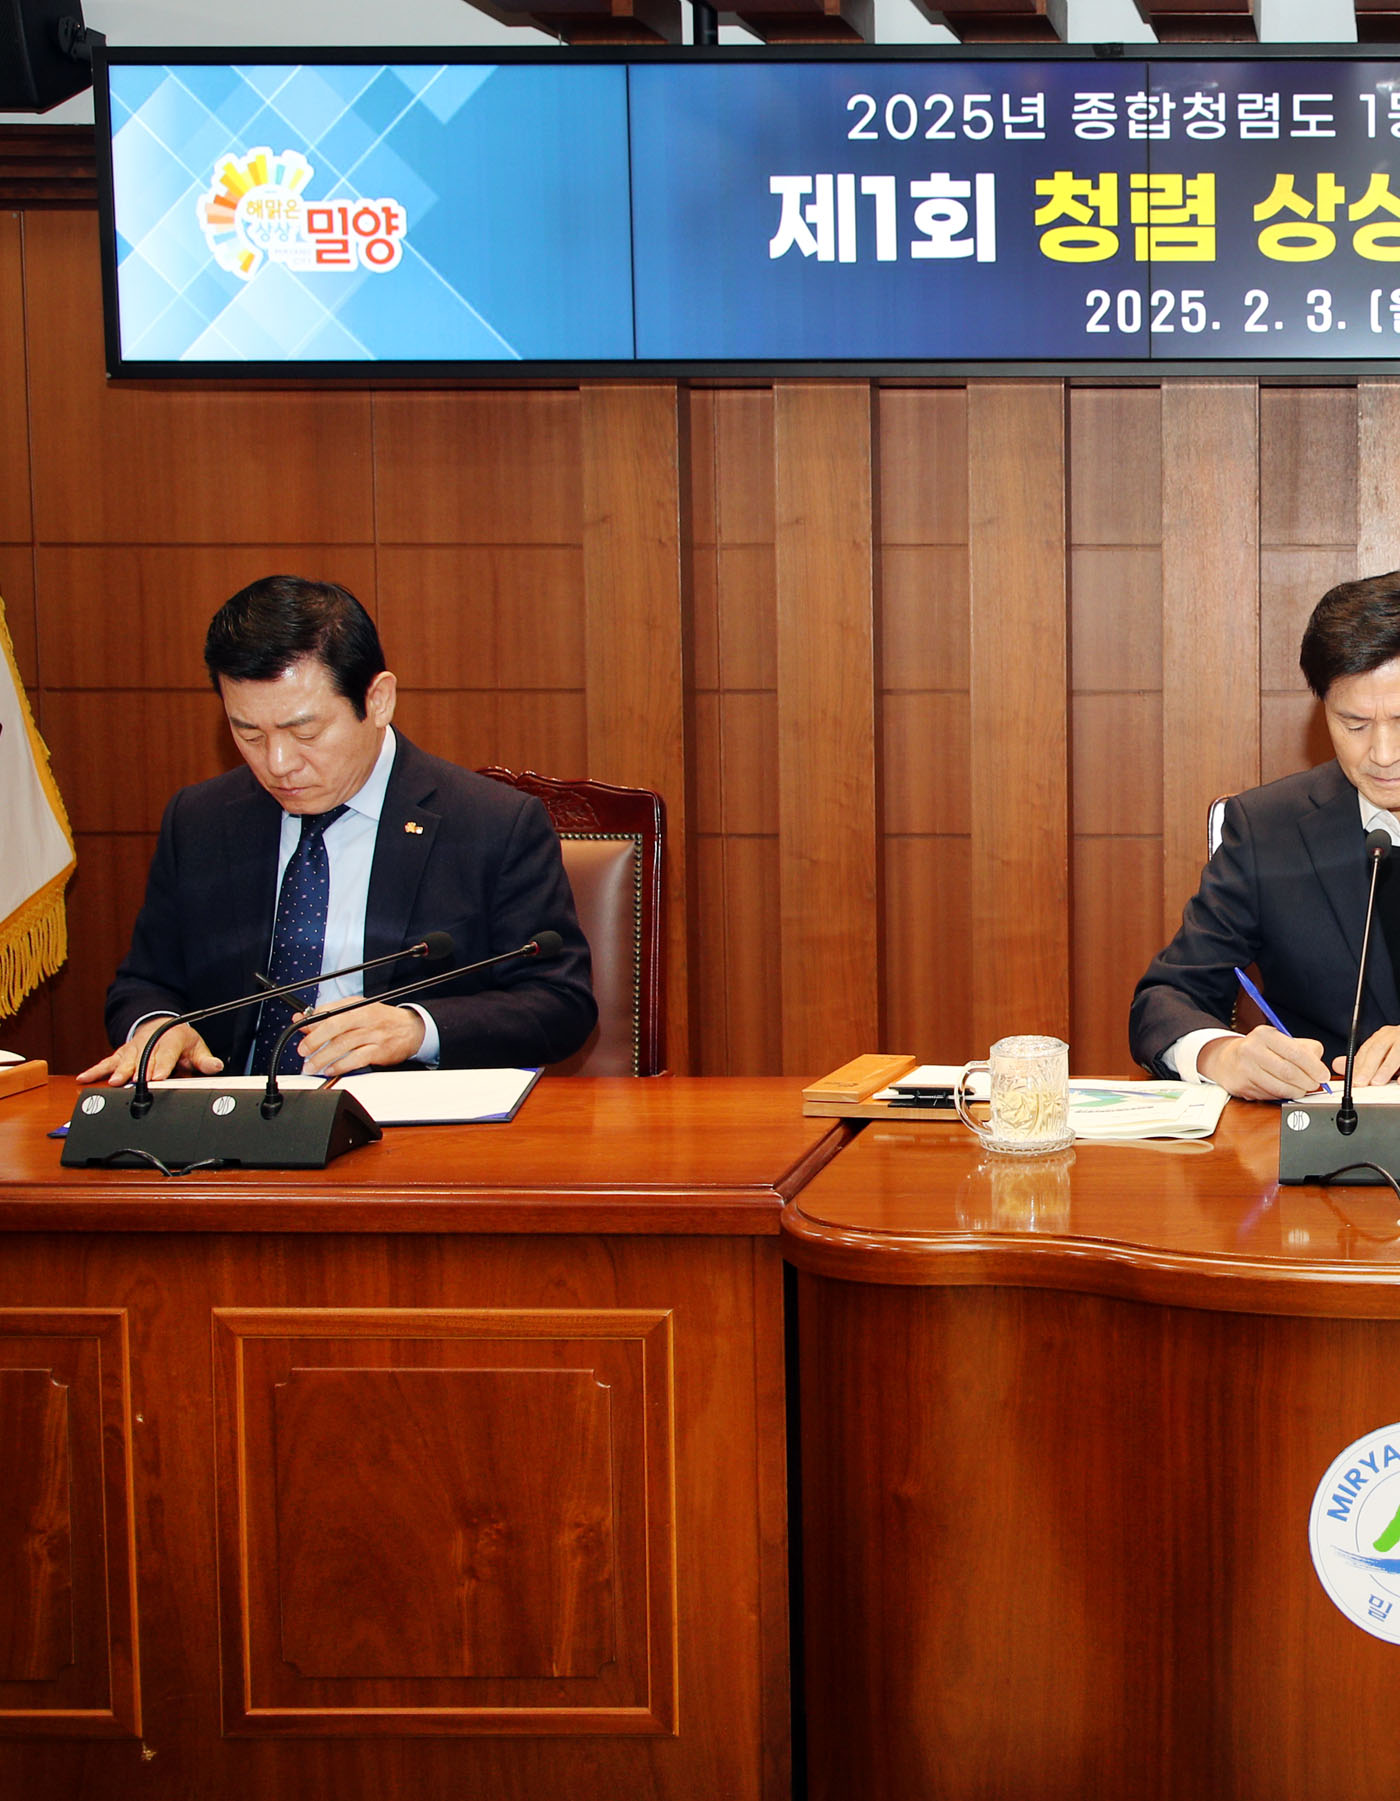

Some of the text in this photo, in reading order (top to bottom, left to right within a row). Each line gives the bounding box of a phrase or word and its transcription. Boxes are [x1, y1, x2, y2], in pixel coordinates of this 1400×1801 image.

[846, 92, 1046, 140] 2025년
[1071, 91, 1336, 139] 종합청렴도
[246, 199, 300, 220] 해맑은
[256, 221, 291, 243] 상상
[768, 171, 997, 263] 제1회
[1034, 170, 1217, 263] 청렴
[306, 205, 399, 265] 밀양
[1085, 288, 1221, 334] 2025.
[1243, 288, 1284, 333] 2.
[1305, 288, 1347, 333] 3.
